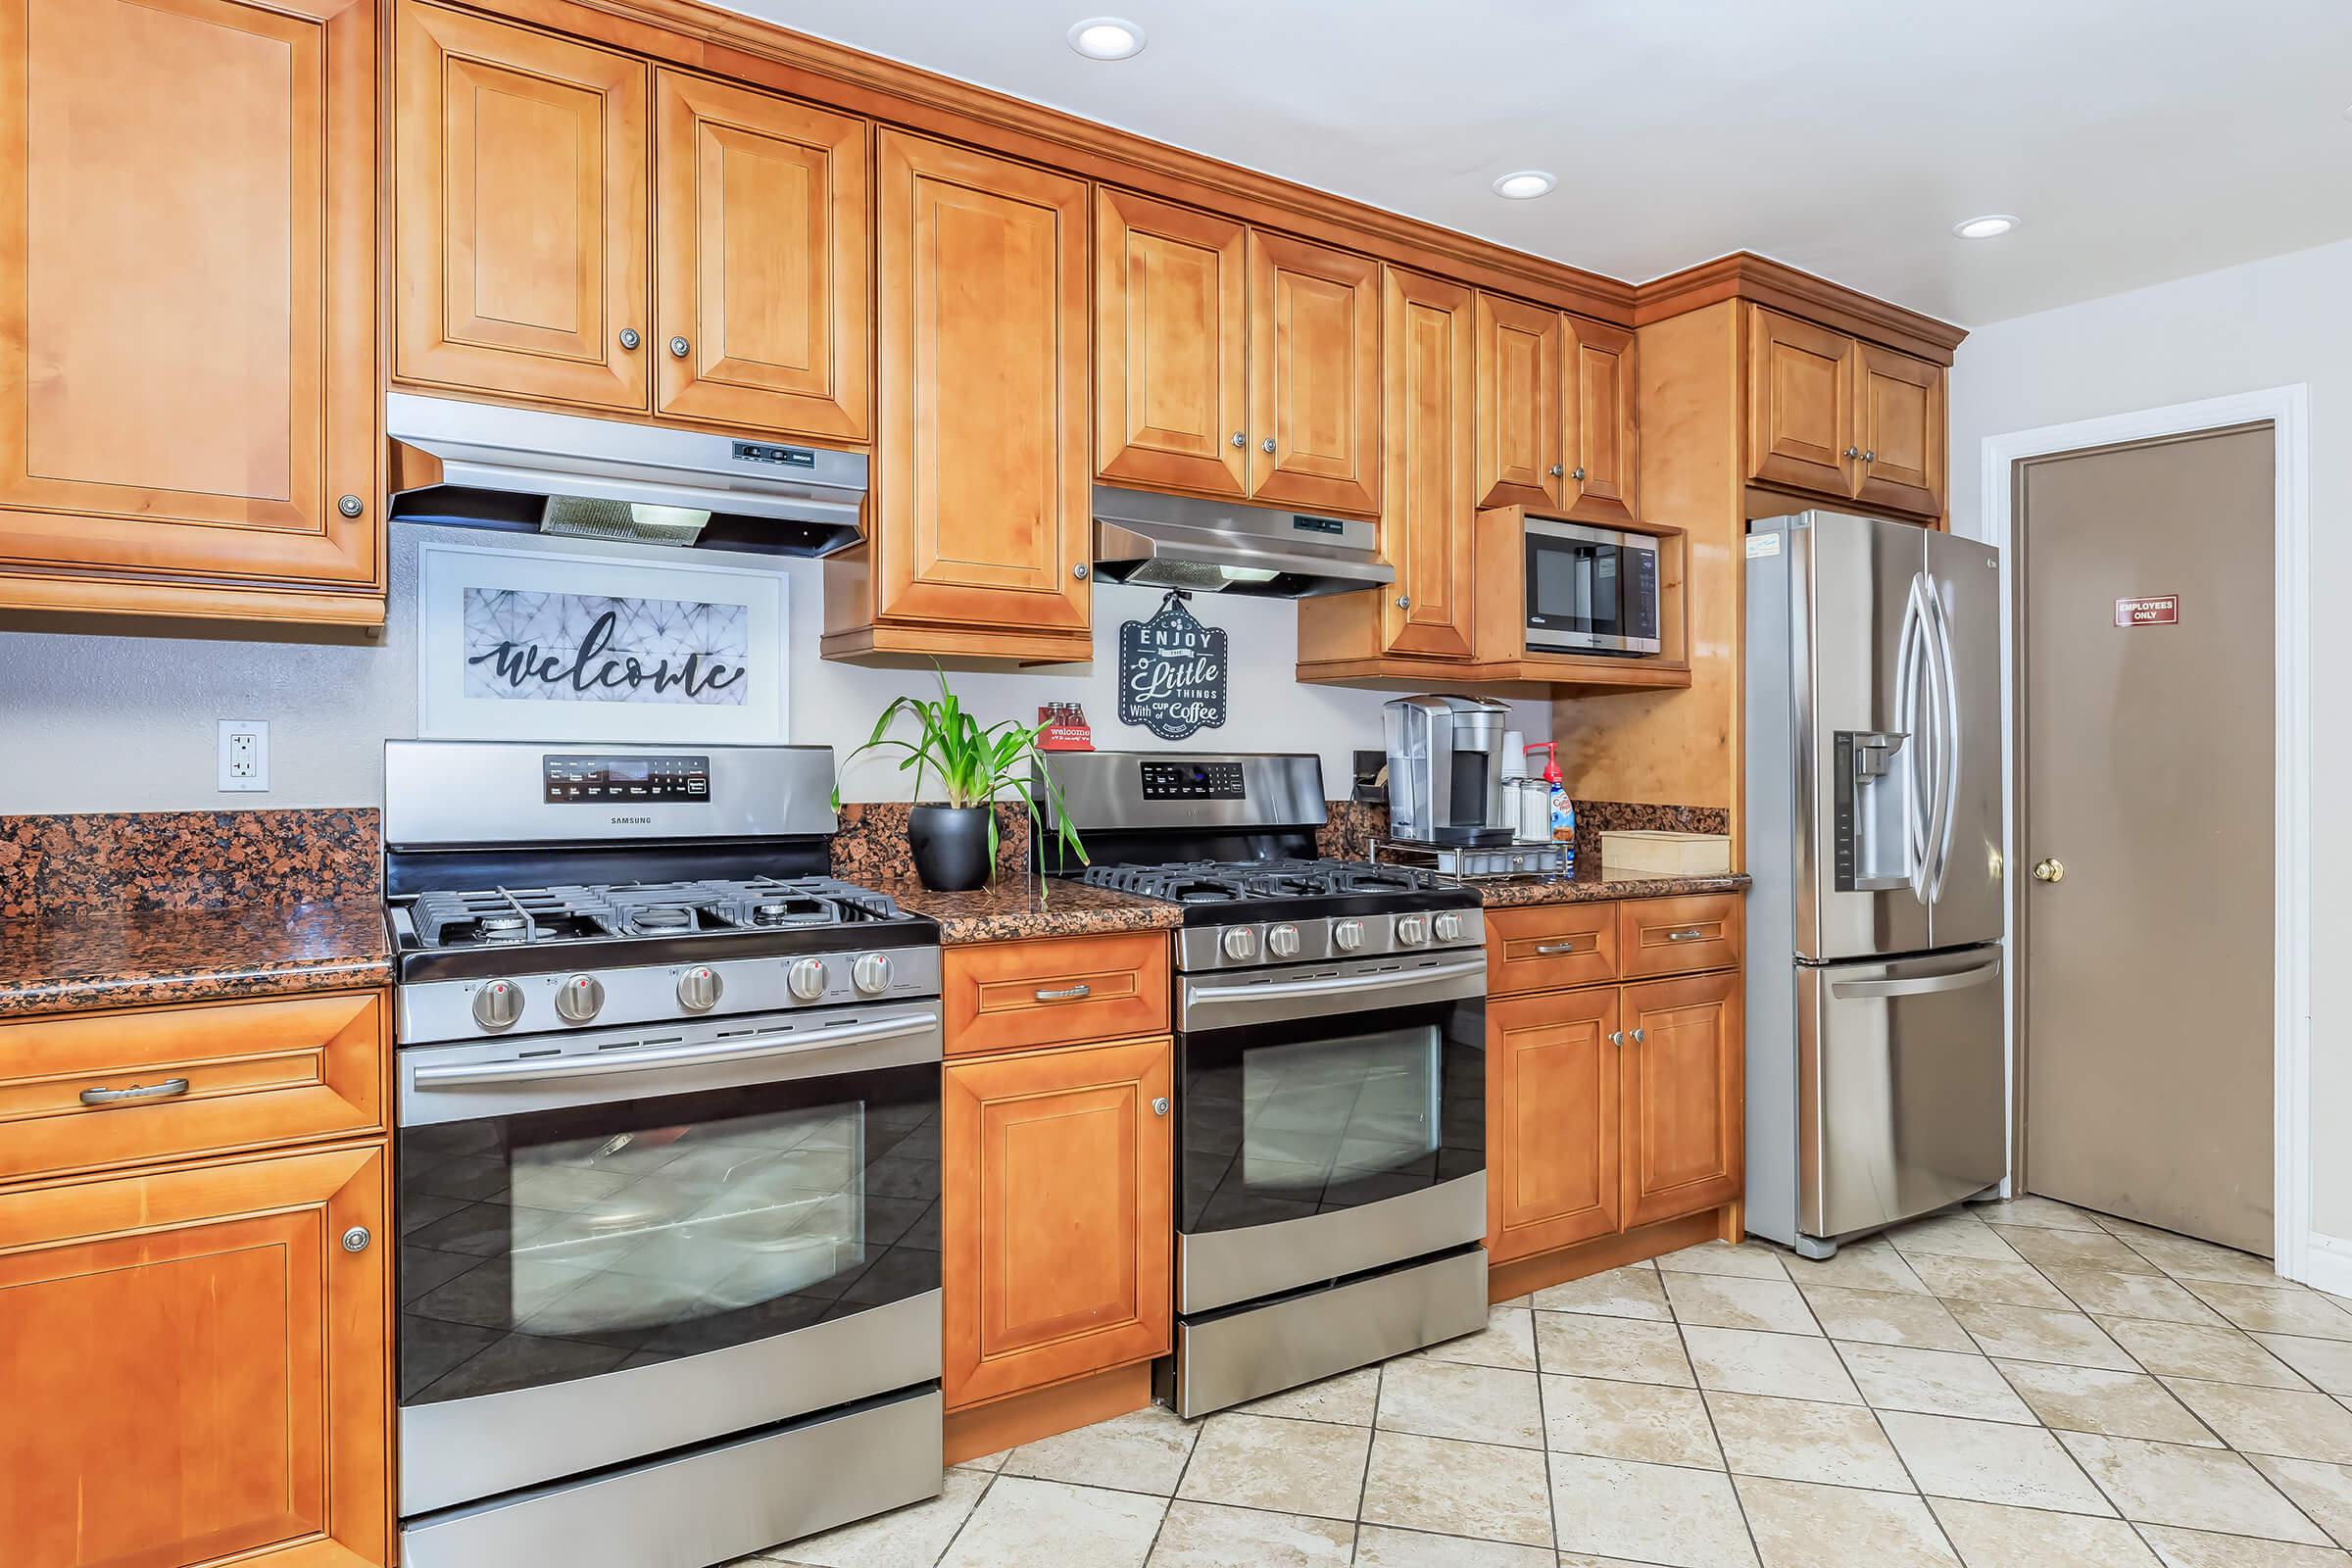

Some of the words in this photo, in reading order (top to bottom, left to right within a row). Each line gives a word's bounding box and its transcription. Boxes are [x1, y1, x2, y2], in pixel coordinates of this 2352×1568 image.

[2119, 602, 2173, 612] EMPLOYEES
[1140, 629, 1211, 648] ENJOY
[468, 611, 746, 698] welcome
[1131, 657, 1219, 703] Little
[1177, 688, 1217, 699] THINGS
[1130, 704, 1152, 717] With
[1152, 702, 1169, 710] CUP
[1169, 701, 1219, 723] Coffee
[1154, 711, 1164, 720] of
